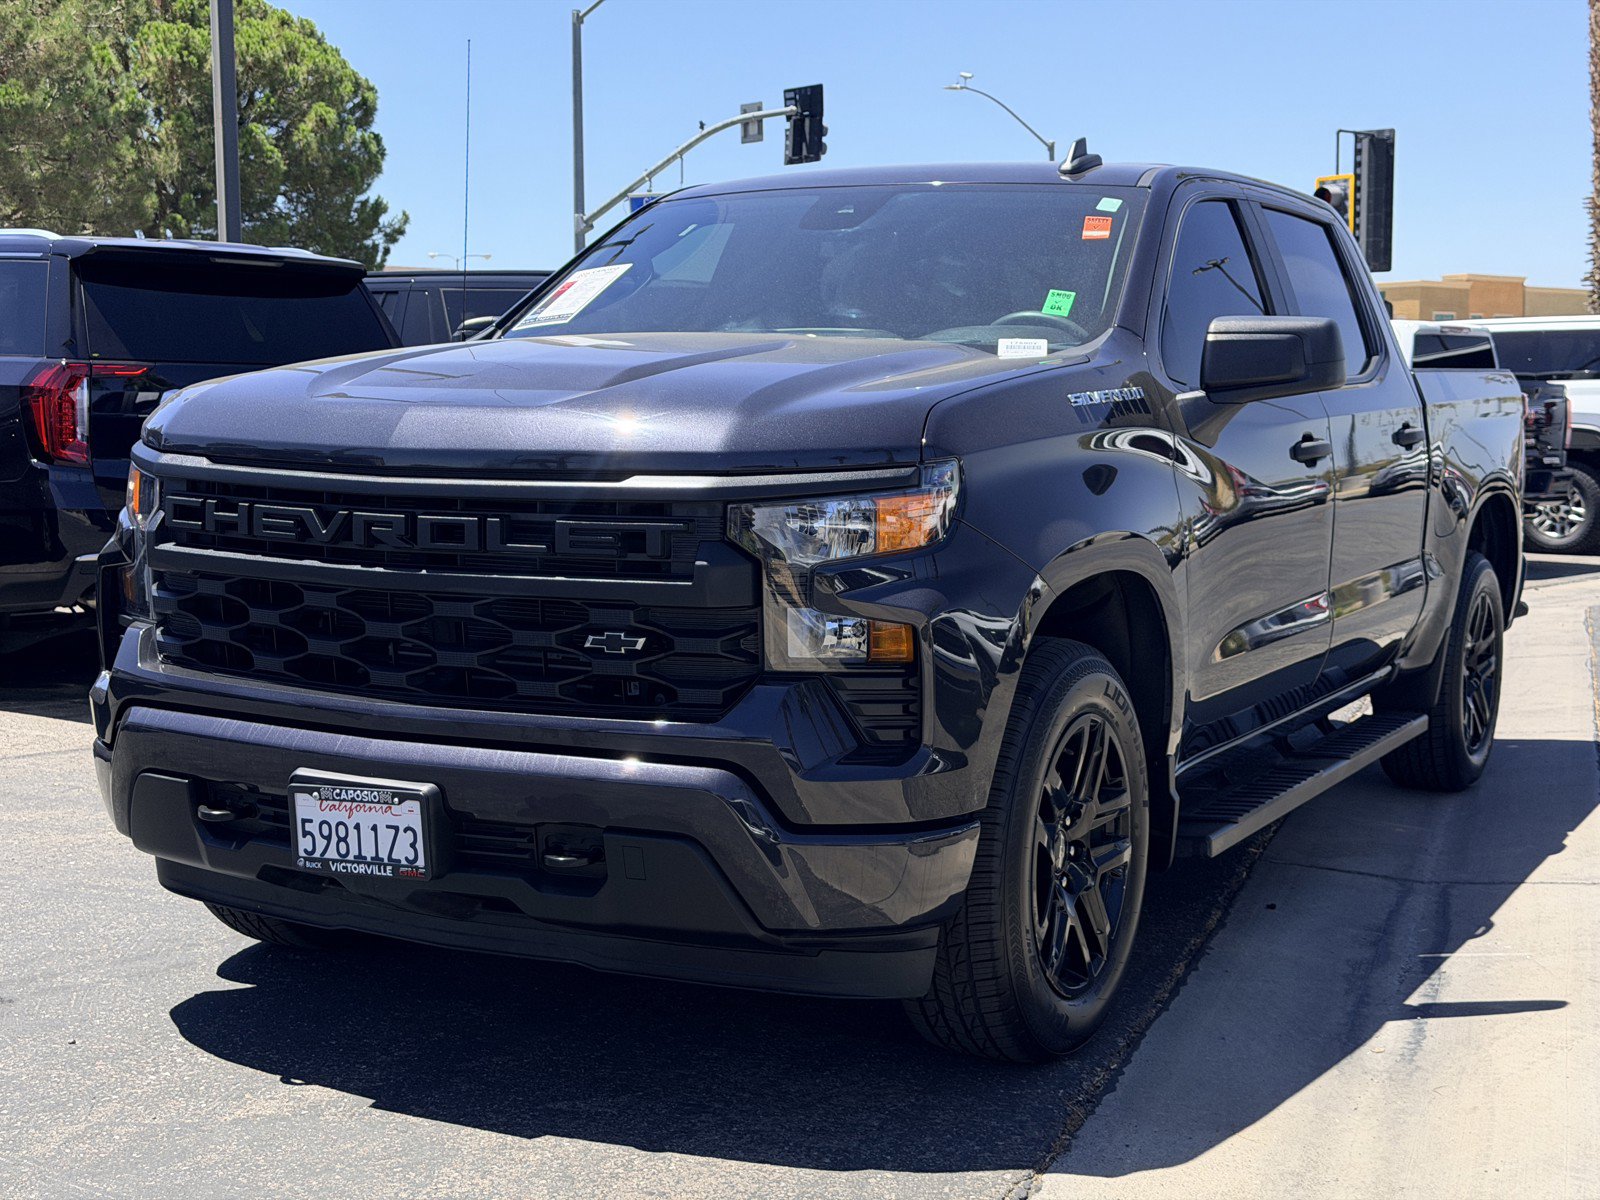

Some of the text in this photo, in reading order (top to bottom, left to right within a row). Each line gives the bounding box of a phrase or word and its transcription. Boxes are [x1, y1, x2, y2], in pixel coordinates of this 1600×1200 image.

[165, 495, 695, 559] CHEVROLET
[333, 788, 380, 802] CAPOSIO
[319, 800, 402, 819] California
[305, 861, 322, 869] BUICK
[329, 861, 393, 876] VICTORVILLE
[399, 867, 426, 878] GMC
